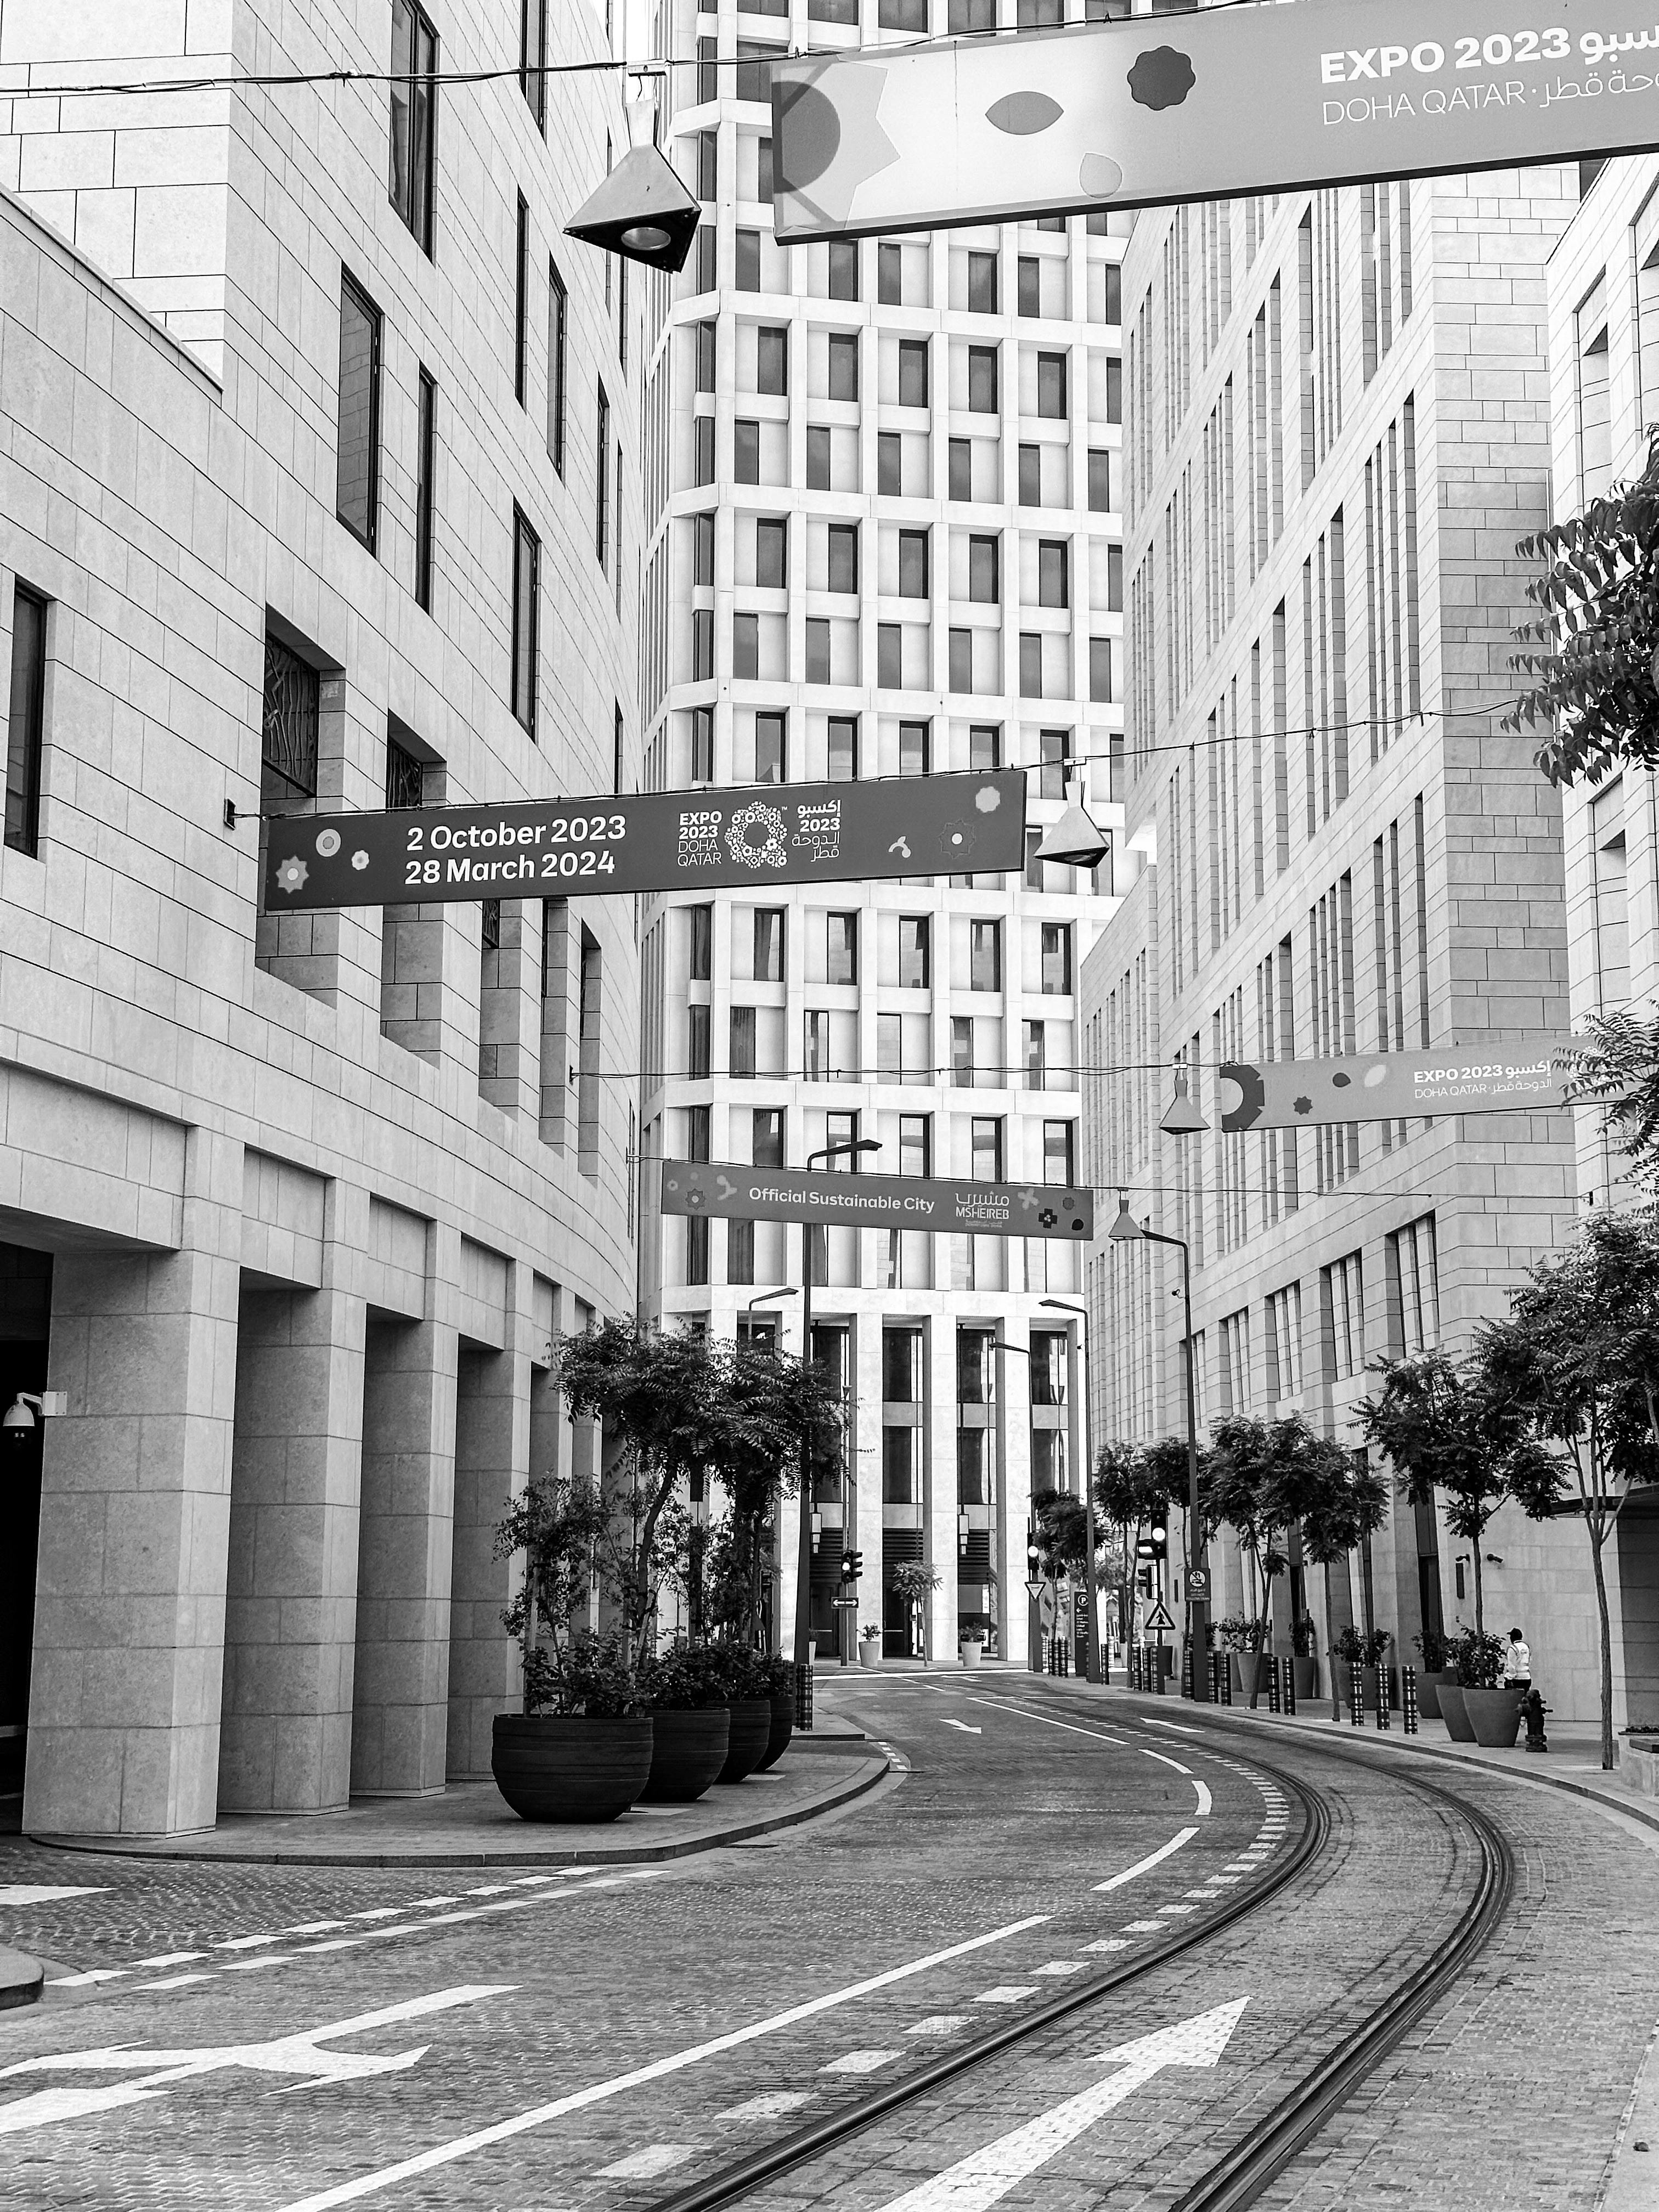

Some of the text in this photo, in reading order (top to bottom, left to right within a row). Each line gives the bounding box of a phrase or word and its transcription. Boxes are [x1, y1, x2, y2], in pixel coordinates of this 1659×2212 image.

[1579, 24, 1659, 65] سبو
[1320, 26, 1571, 84] EXPO 2023
[1539, 71, 1604, 109] قطر
[1322, 80, 1526, 126] DOHA QATAR
[797, 799, 841, 818] إكسبو
[679, 810, 722, 826] EXPO
[800, 817, 841, 833] 2023
[407, 815, 627, 851] 2 October 2023
[679, 825, 718, 839] 2023
[792, 832, 840, 848] الدوحة
[678, 838, 718, 853] DOHA
[810, 845, 839, 862] قطر
[404, 850, 616, 885] 28 March 2024
[677, 851, 722, 867] QATAR
[1414, 1064, 1503, 1084] EXPO 2023
[1505, 1060, 1551, 1079] إكسبو
[1414, 1083, 1487, 1098] DOHA QATAR
[1491, 1078, 1552, 1094] الدوحة قطر
[749, 1187, 935, 1214] Official Sustainable City
[956, 1206, 1009, 1219] MSHEIREB
